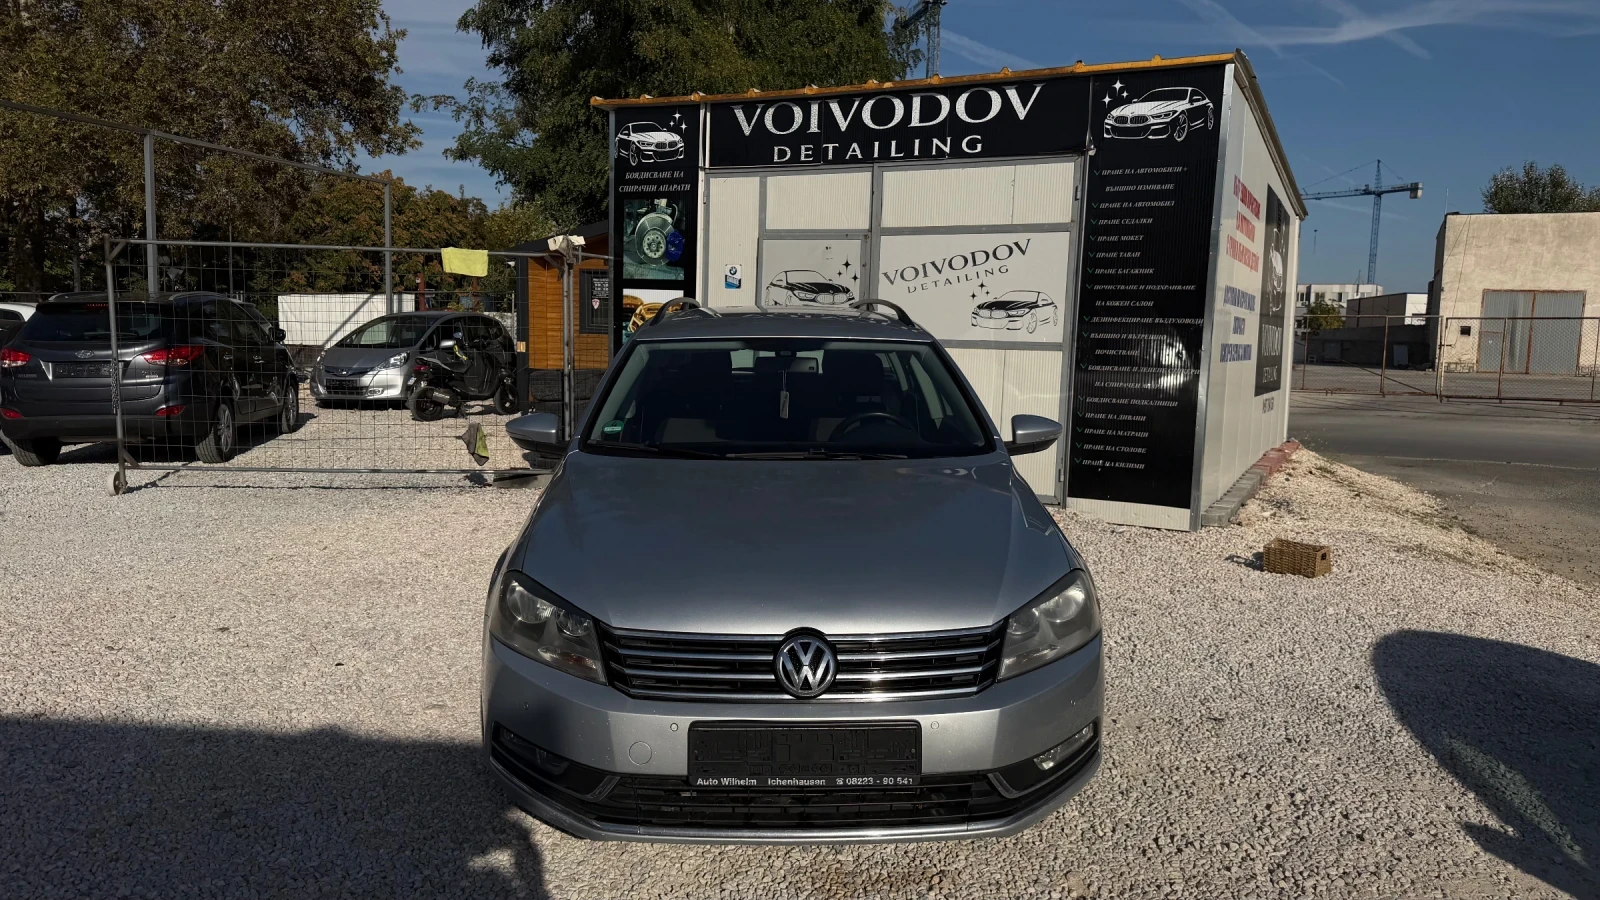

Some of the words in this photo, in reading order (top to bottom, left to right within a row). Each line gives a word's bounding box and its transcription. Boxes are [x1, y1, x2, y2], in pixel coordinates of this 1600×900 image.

[730, 83, 1046, 137] VOIVODOV
[773, 135, 983, 163] DETAILING
[625, 171, 673, 180] БОЯДИСВАНЕ
[673, 170, 684, 178] НА
[1101, 168, 1124, 176] ПРАНЕ
[1133, 166, 1182, 174] АВТОМОБИЛИ
[618, 184, 657, 193] СПИРАЧНИ
[657, 183, 691, 192] АПАРАТИ
[1105, 184, 1137, 192] ВЪНШНО
[1136, 183, 1175, 191] ИЗМИВАНЕ
[1132, 200, 1175, 208] АВТОМОБИЛ
[881, 238, 1032, 286] VOIVODOV
[907, 264, 1009, 294] DETAILING
[1116, 414, 1146, 422] ДИВАНИ
[1116, 430, 1149, 438] МАТРАЦИ
[1115, 446, 1147, 454] СТОЛОВЕ
[1114, 461, 1145, 470] КИЛИМИ
[696, 777, 719, 786] Auto
[720, 777, 757, 786] Wilhelm
[767, 777, 826, 786] Ichenhausen
[846, 777, 874, 785] 08223
[882, 777, 894, 785] 90
[896, 777, 913, 785] 541
